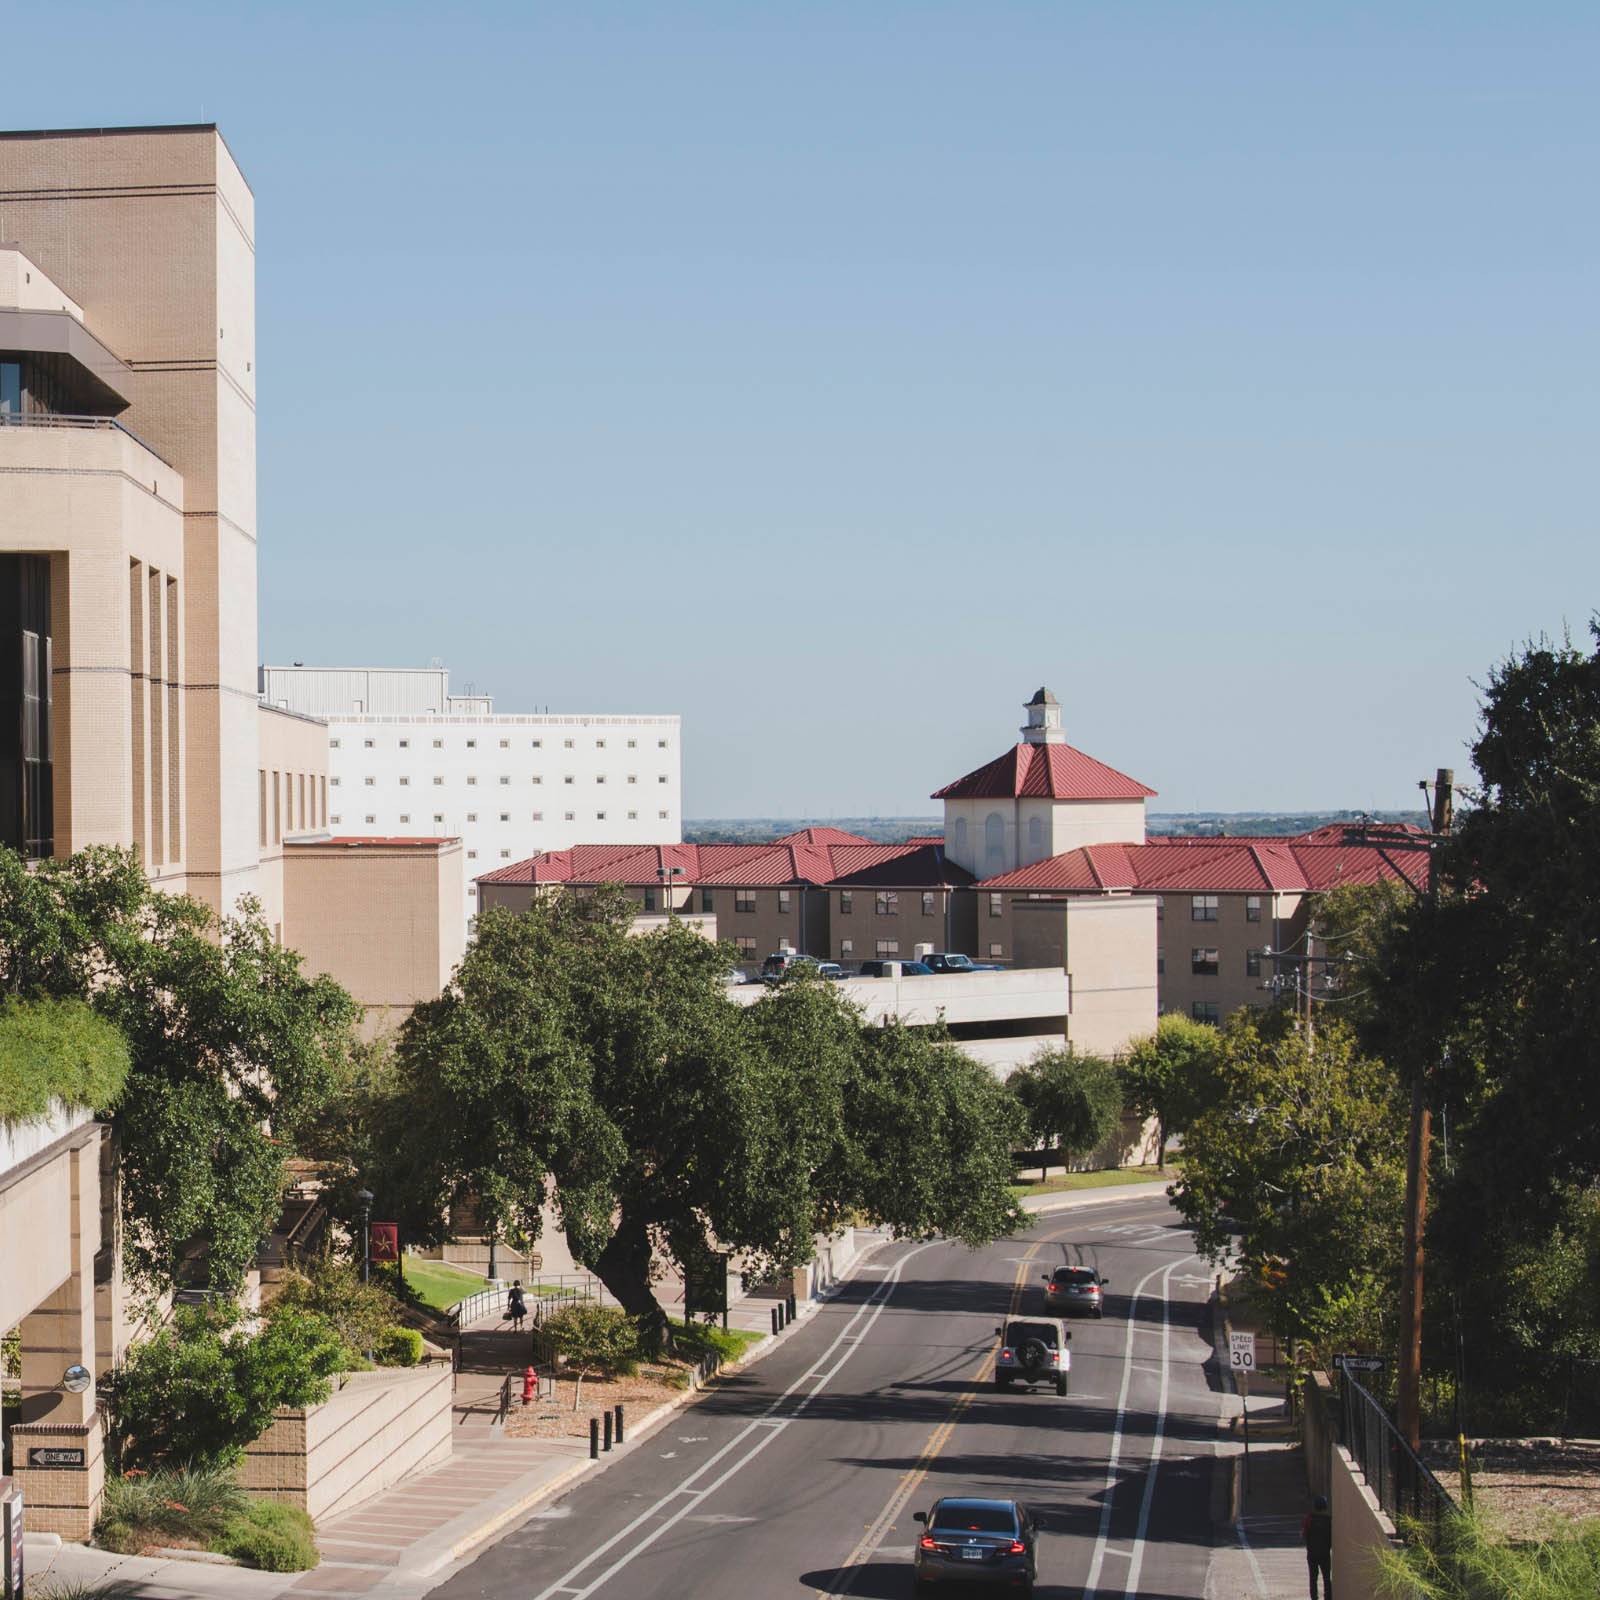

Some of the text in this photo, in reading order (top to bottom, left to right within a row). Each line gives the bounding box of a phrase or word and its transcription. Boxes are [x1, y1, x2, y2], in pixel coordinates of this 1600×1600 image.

[1231, 1335, 1252, 1343] SPEED
[1232, 1351, 1252, 1366] 30
[45, 1453, 79, 1461] ONE WAY
